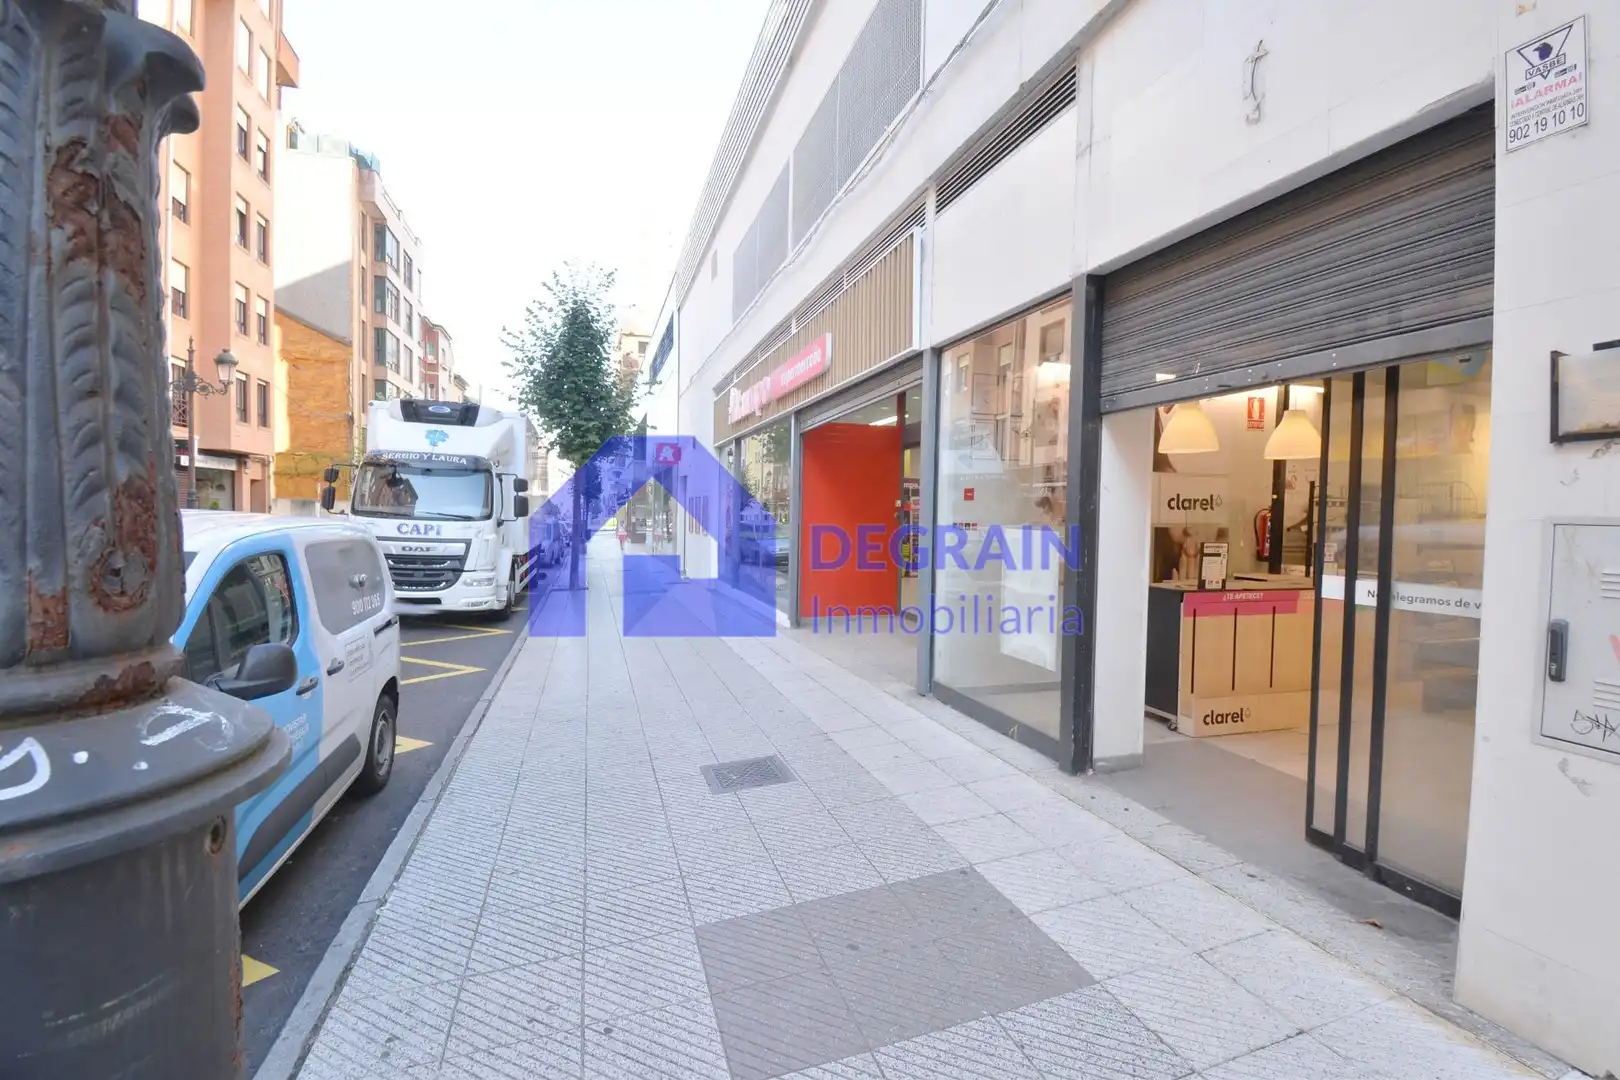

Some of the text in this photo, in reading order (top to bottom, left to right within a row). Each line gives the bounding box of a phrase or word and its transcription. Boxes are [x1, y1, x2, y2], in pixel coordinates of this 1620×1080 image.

[1528, 56, 1563, 76] VASBE
[1511, 71, 1581, 109] ¡ALARMA!
[1509, 100, 1584, 144] 902 19 10 10
[381, 452, 467, 465] SERGIO Y LAURA
[1167, 493, 1215, 511] clarel
[396, 523, 441, 536] CAPI
[1454, 599, 1470, 608] de
[1203, 708, 1244, 726] clarel
